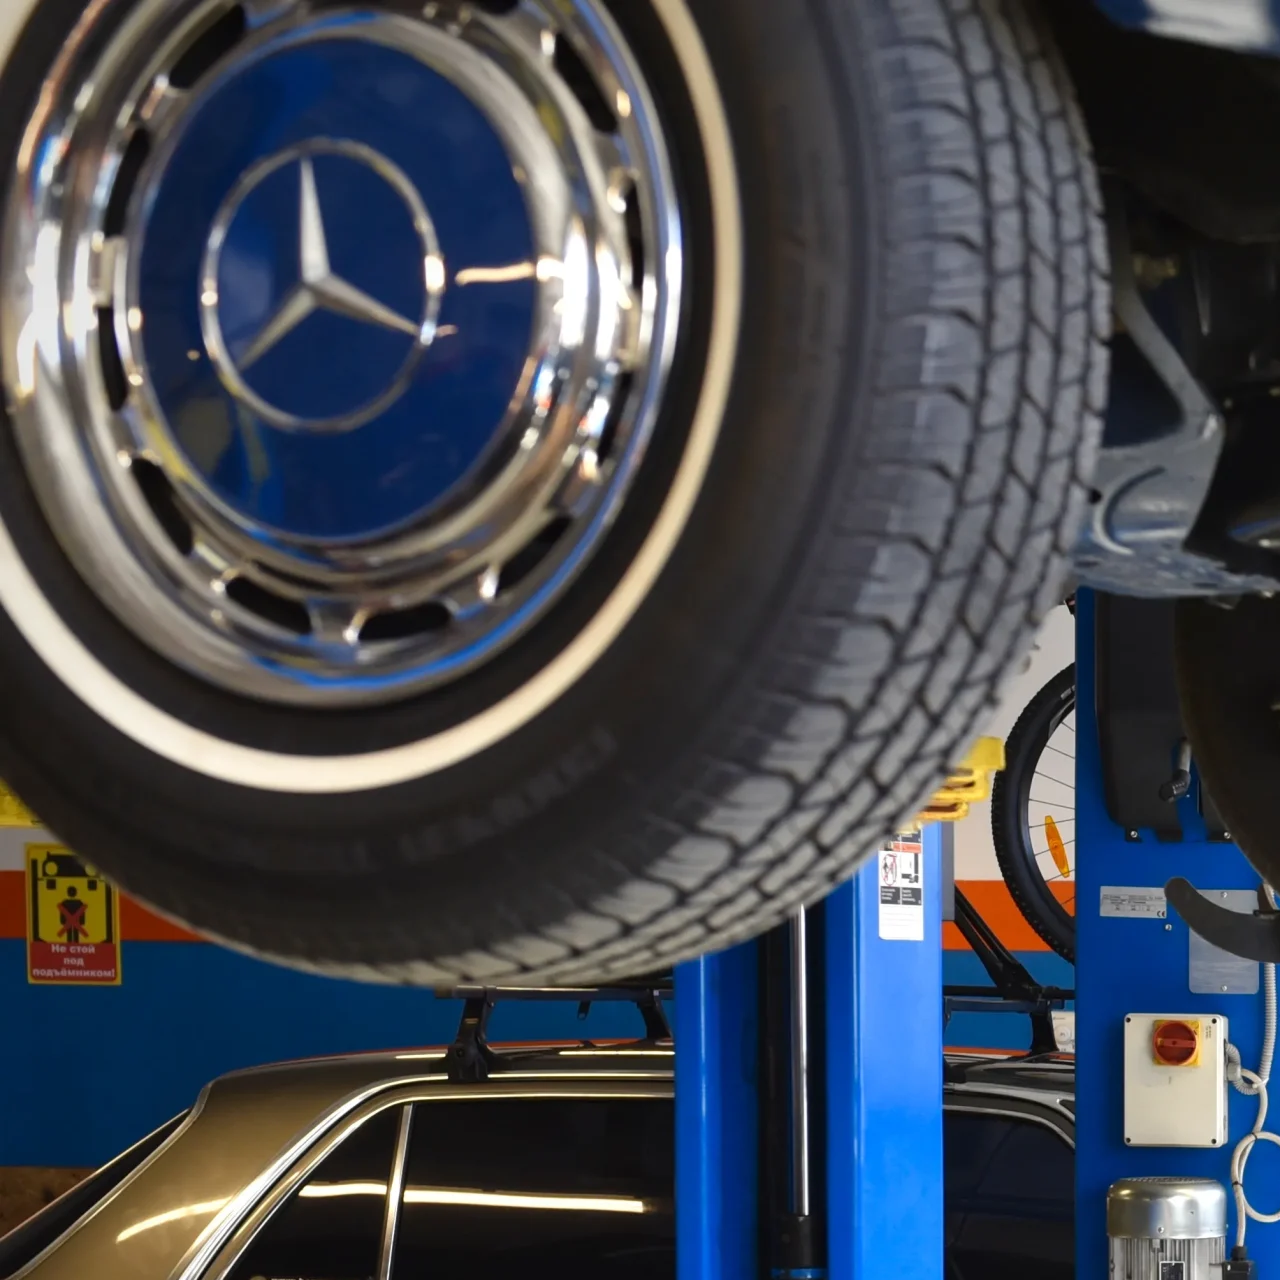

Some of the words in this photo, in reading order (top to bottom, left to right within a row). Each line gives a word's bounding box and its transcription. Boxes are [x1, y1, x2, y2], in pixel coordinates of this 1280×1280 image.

[51, 943, 67, 953] Не
[69, 945, 95, 954] стой
[63, 957, 85, 966] под
